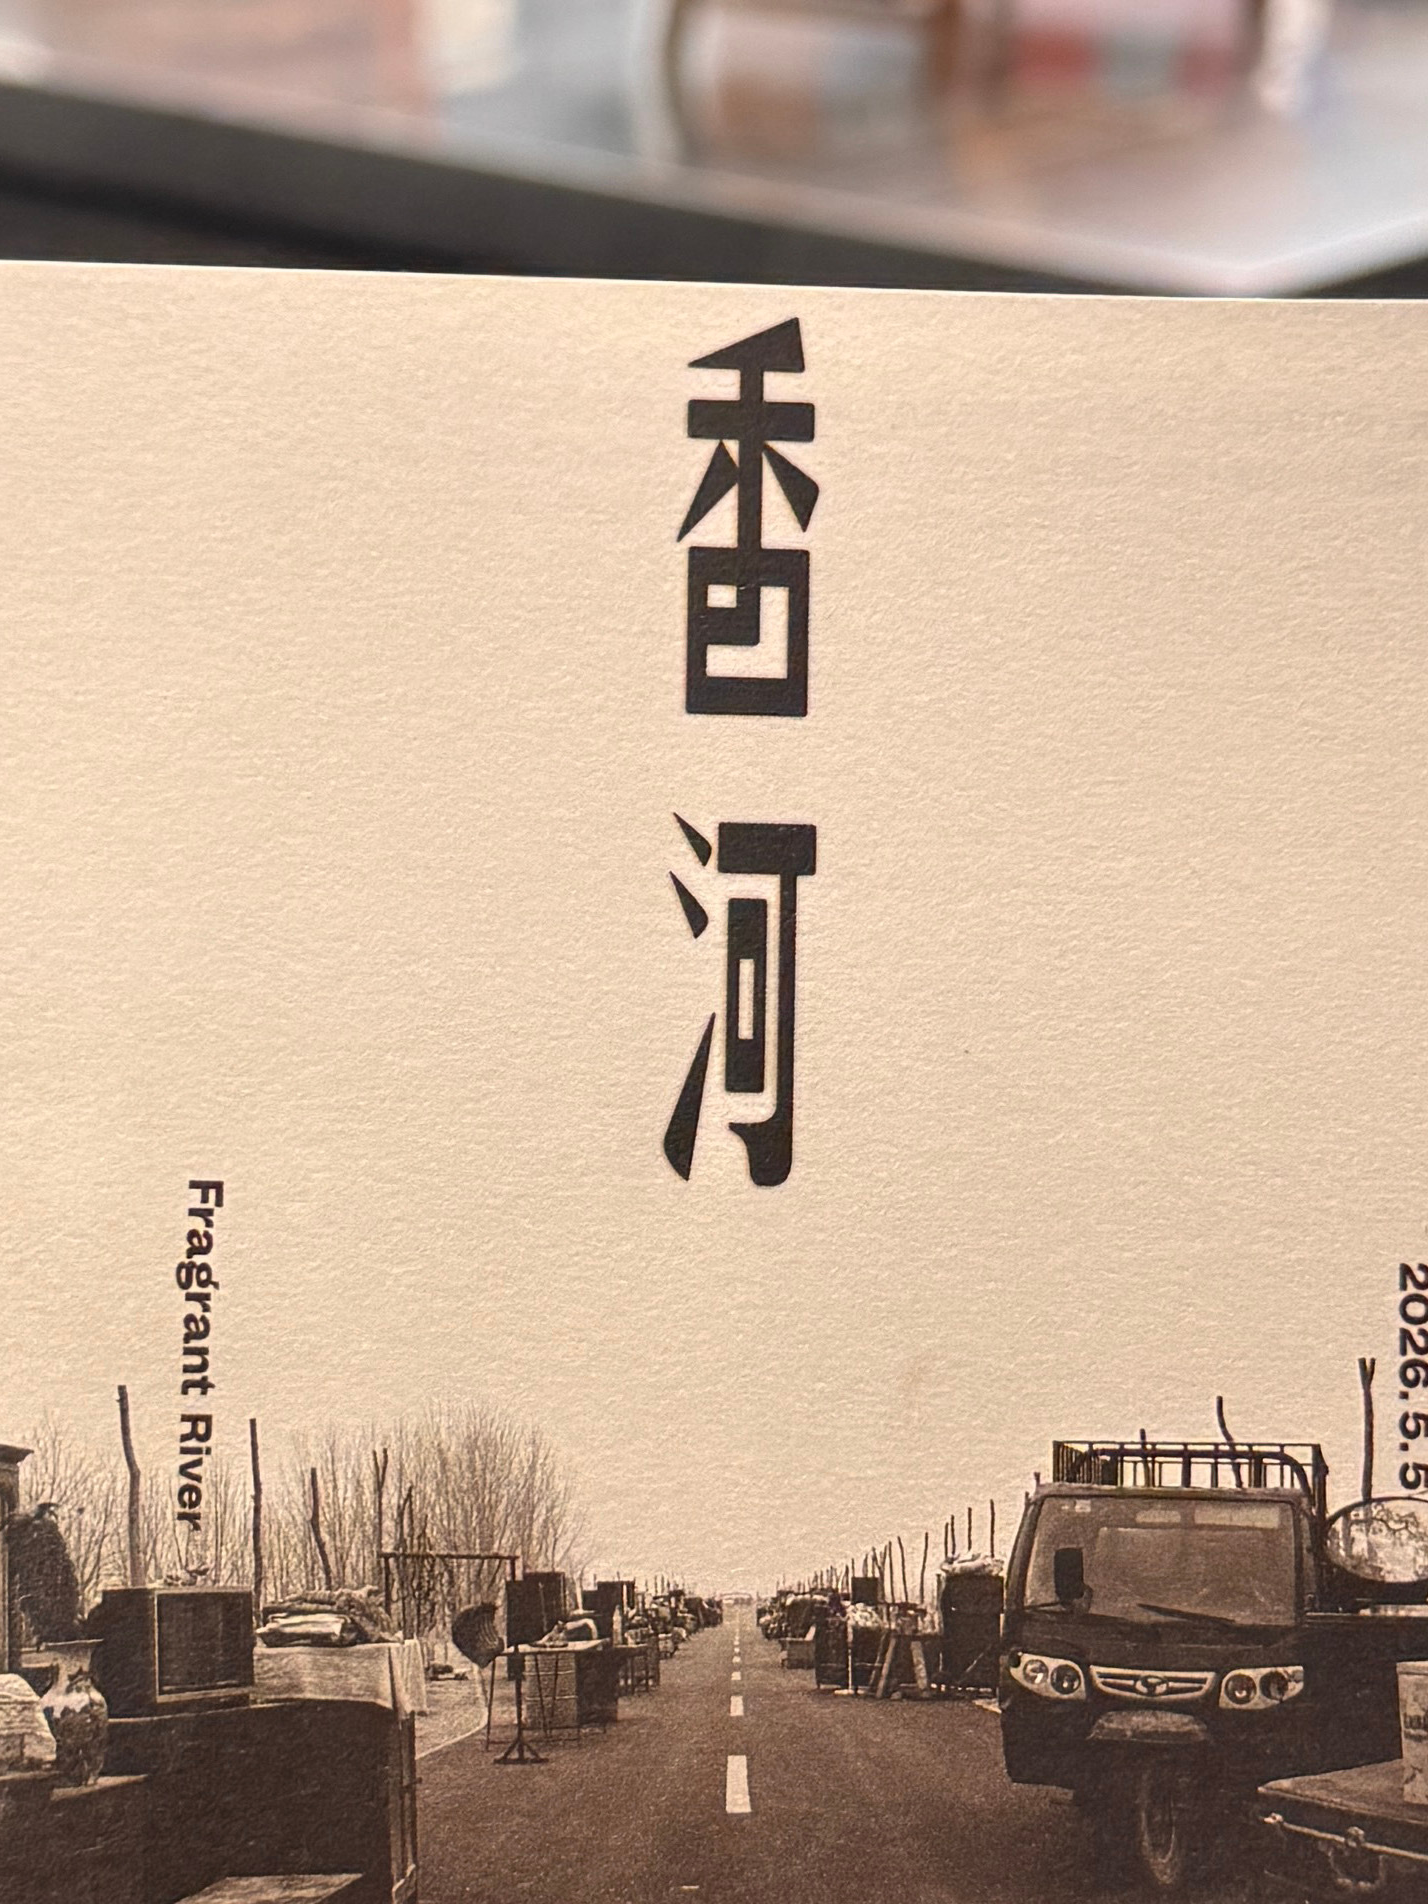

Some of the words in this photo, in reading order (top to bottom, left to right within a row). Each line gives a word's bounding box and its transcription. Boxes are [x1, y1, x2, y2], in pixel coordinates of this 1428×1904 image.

[662, 316, 820, 1188] 香河
[175, 1179, 225, 1396] Fragrant
[175, 1413, 214, 1532] River
